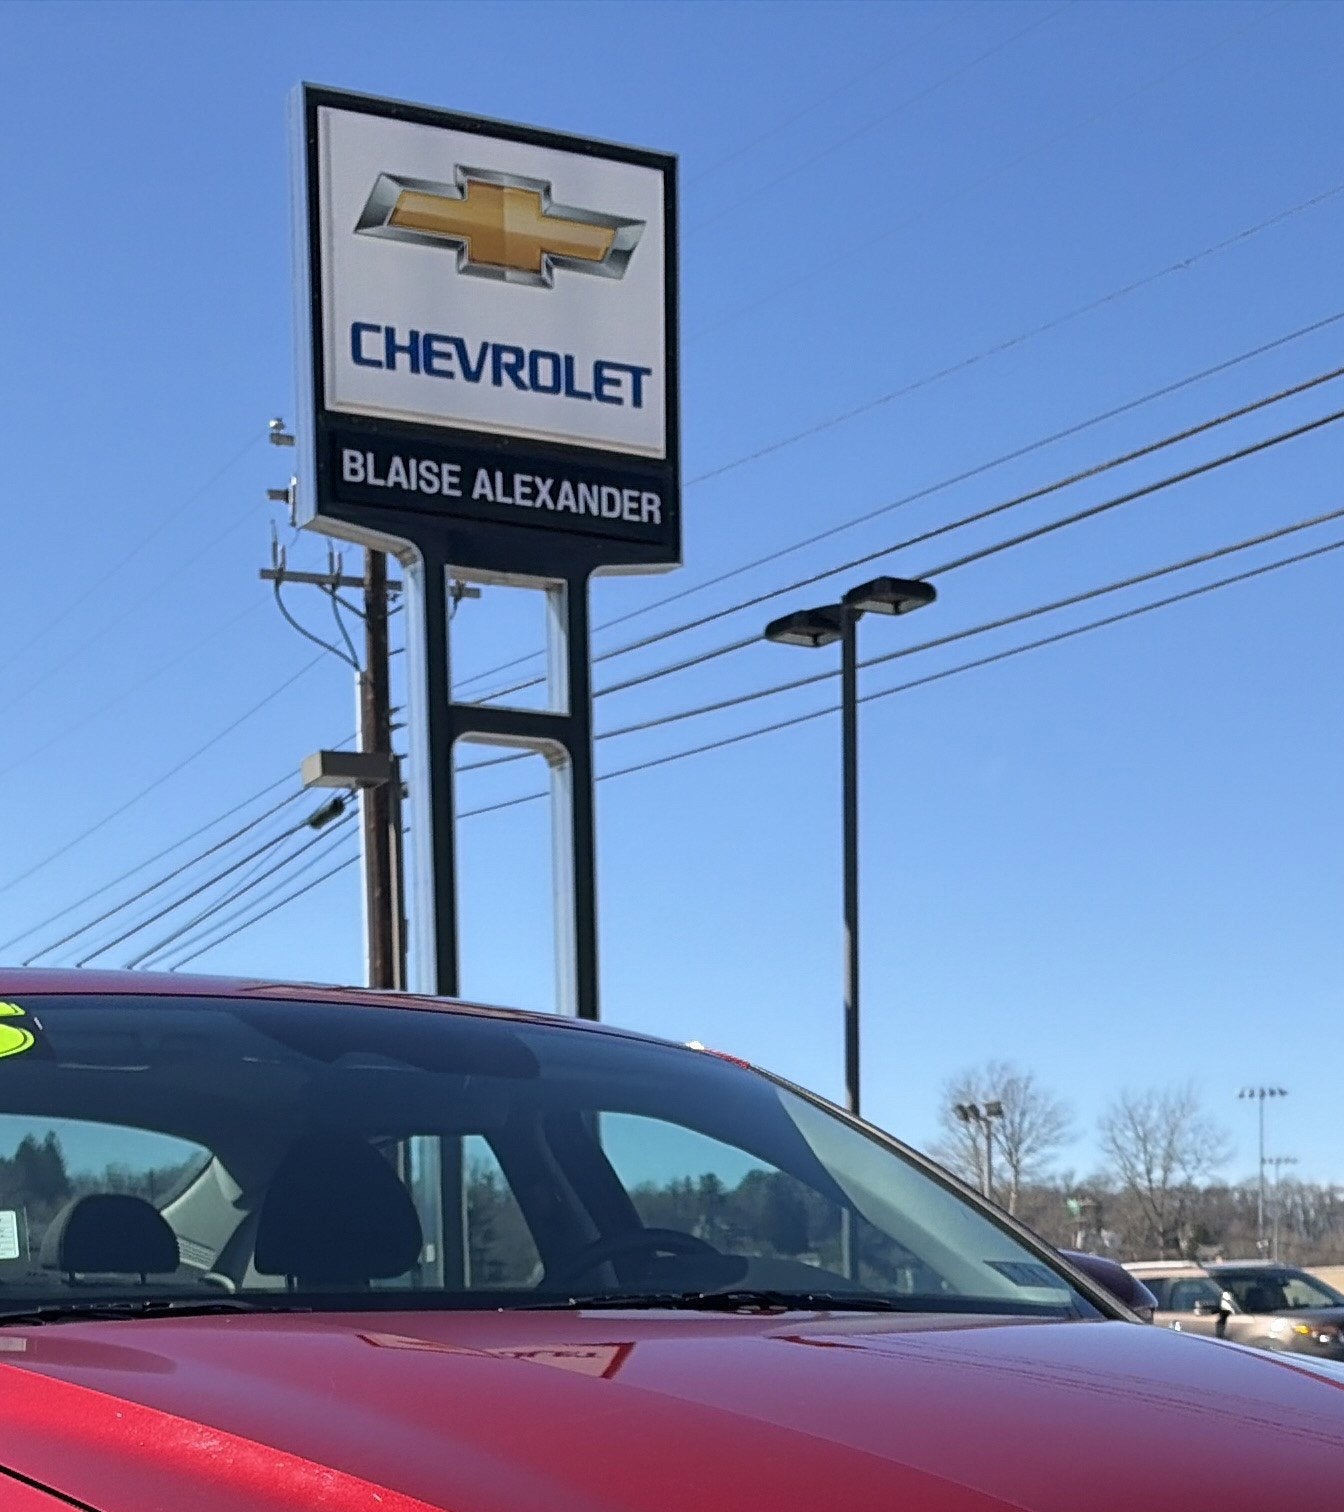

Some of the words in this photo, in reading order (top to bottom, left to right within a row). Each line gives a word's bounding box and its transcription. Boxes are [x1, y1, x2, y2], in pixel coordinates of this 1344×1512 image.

[350, 321, 652, 409] CHEVROLET
[341, 448, 463, 498] BLAISE
[472, 468, 662, 525] ALEXANDER
